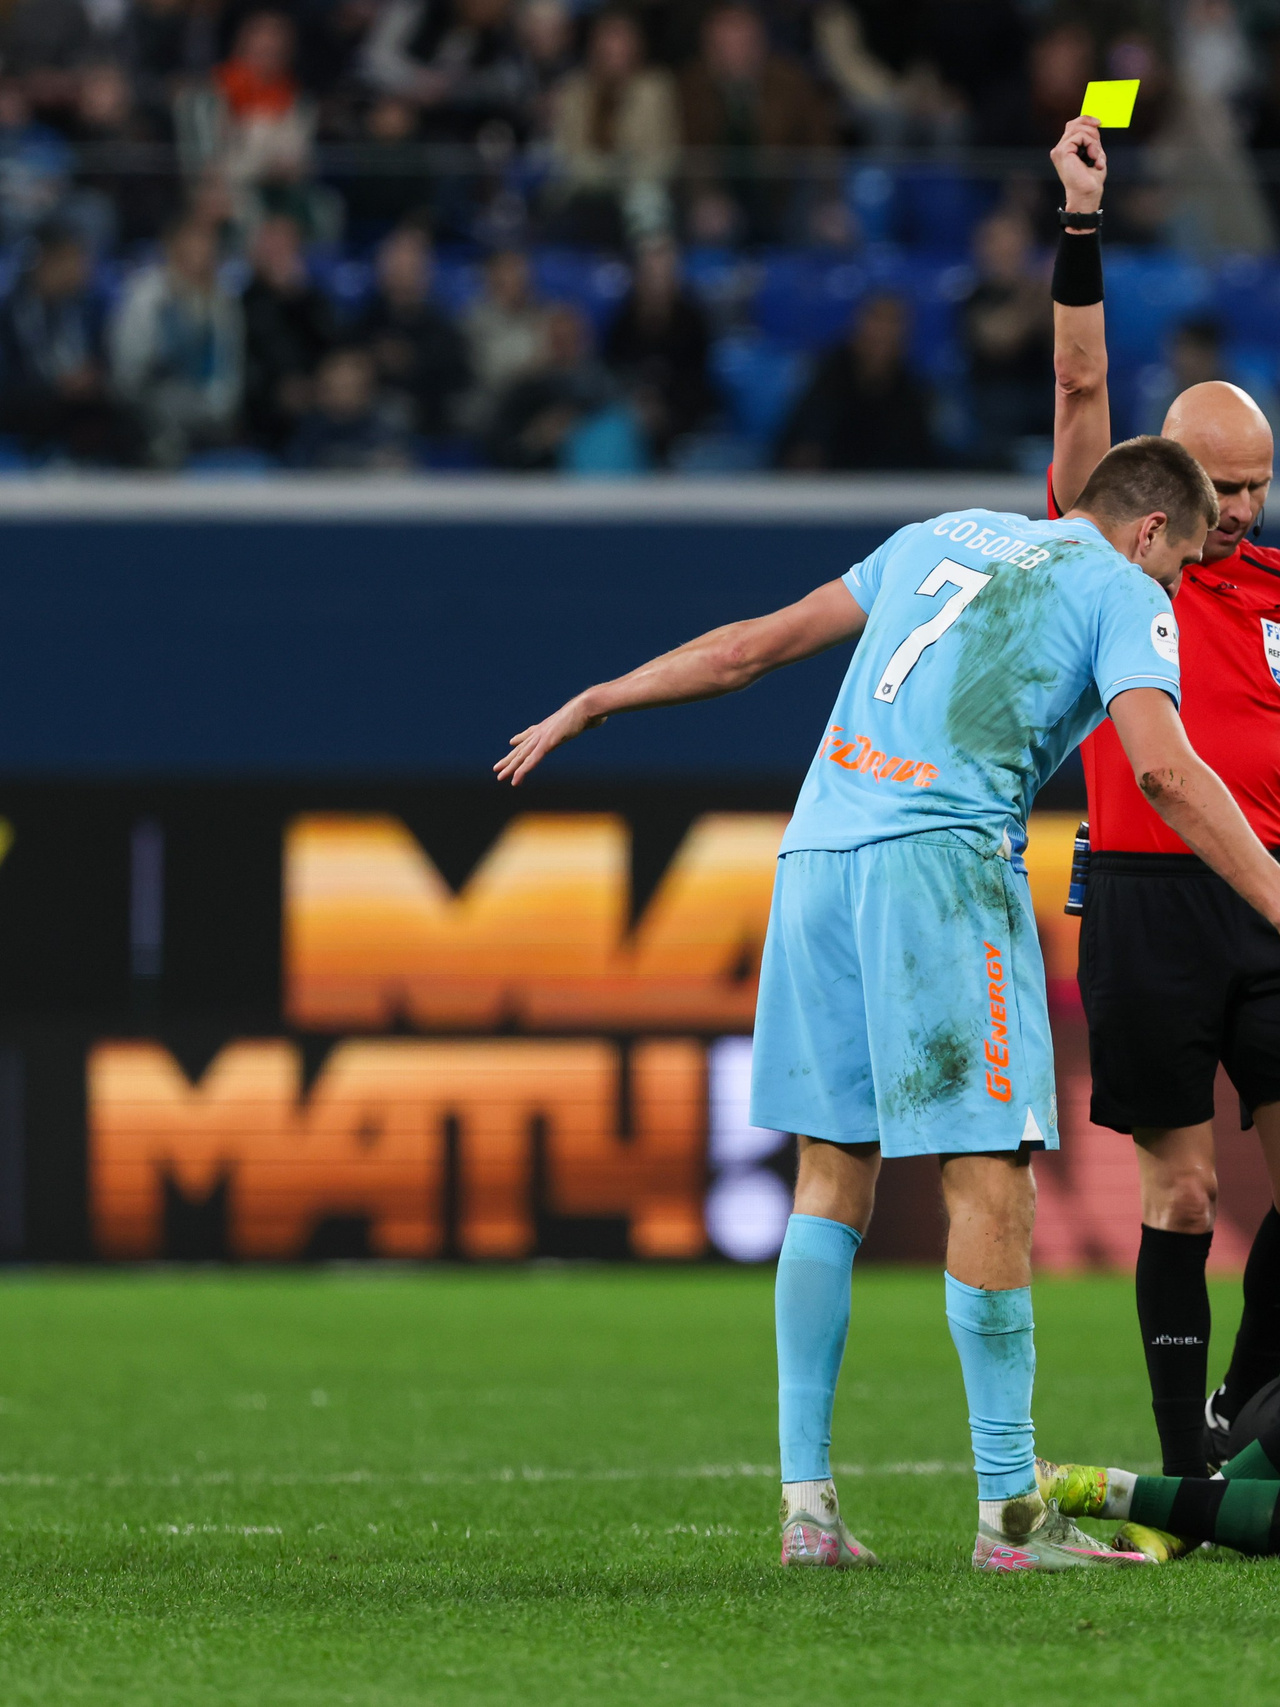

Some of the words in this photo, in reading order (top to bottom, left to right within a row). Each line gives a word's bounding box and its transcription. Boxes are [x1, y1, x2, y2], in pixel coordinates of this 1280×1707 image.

[933, 518, 1051, 570] СОБОЛЕВ
[873, 557, 993, 704] 7
[1151, 1334, 1204, 1345] JÖGEL
